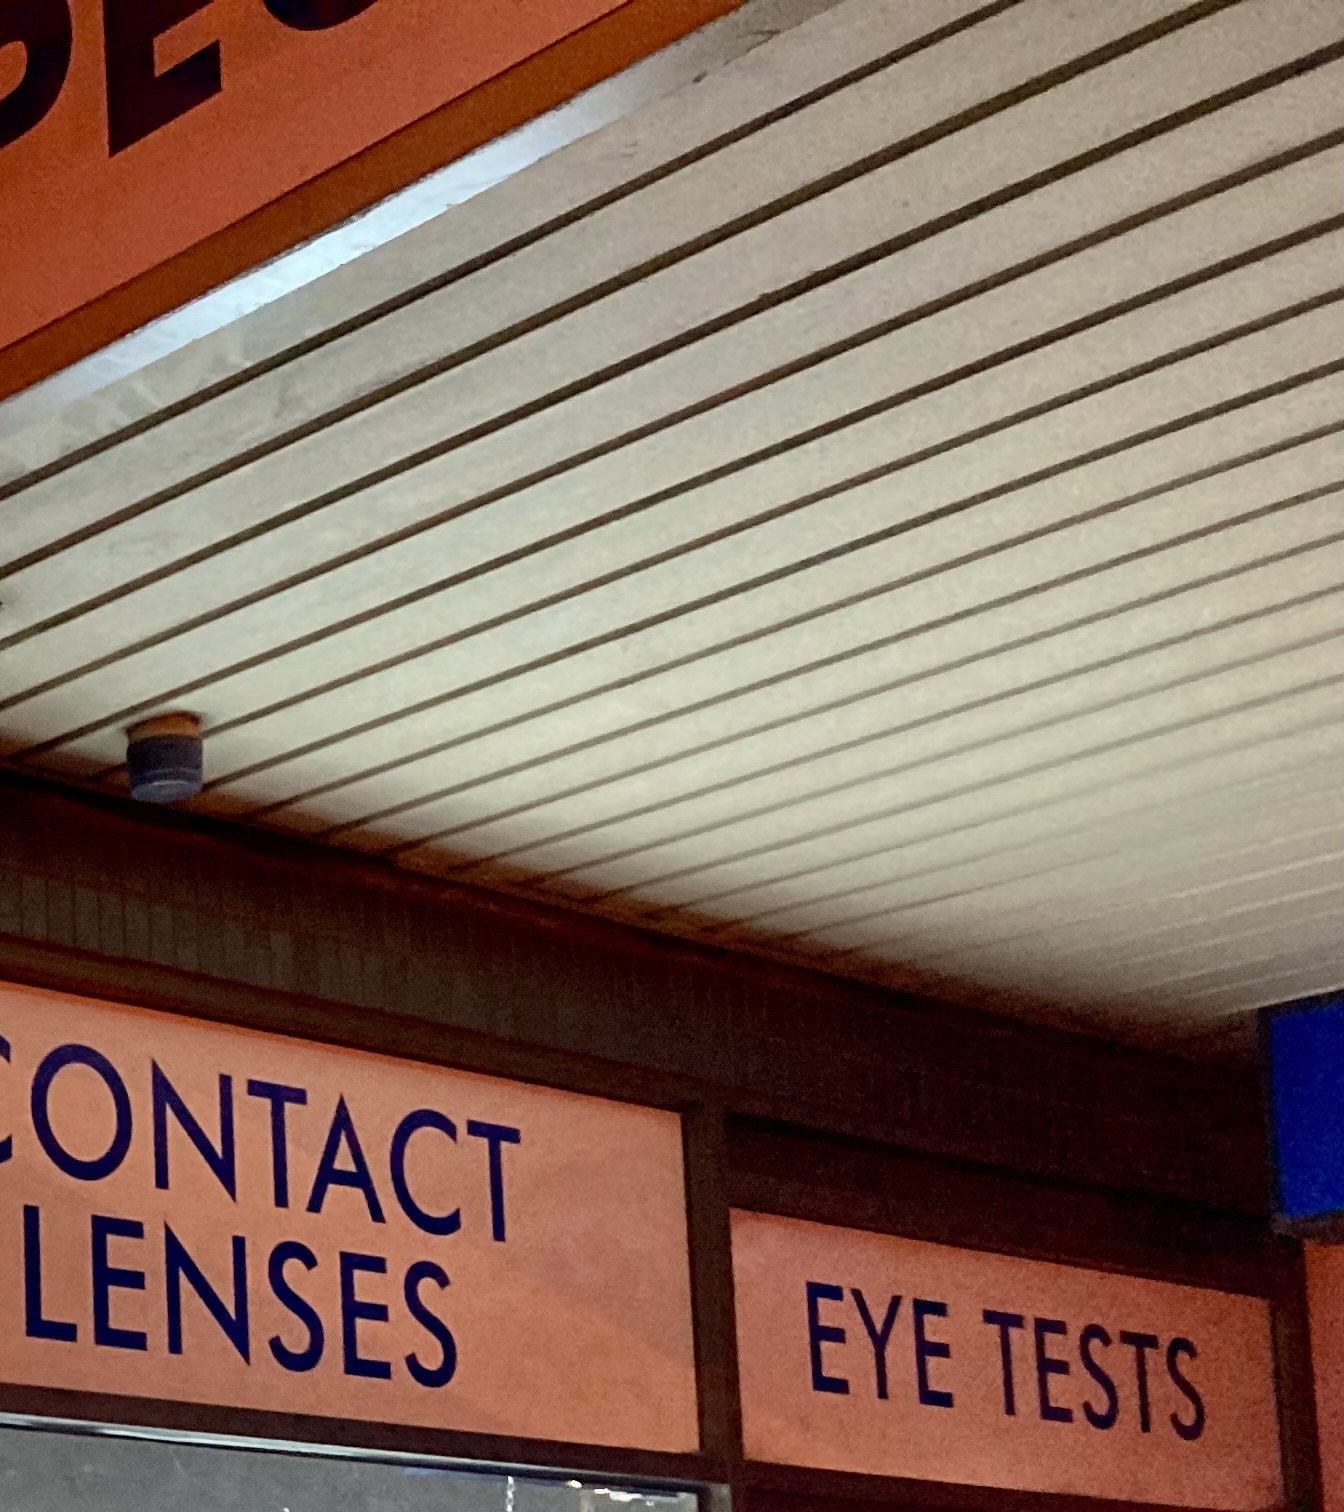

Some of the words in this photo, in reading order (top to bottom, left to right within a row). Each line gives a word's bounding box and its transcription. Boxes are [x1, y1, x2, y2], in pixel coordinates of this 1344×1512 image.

[23, 1204, 457, 1388] LENSES
[806, 1281, 955, 1409] EYE
[983, 1309, 1207, 1442] TESTS
